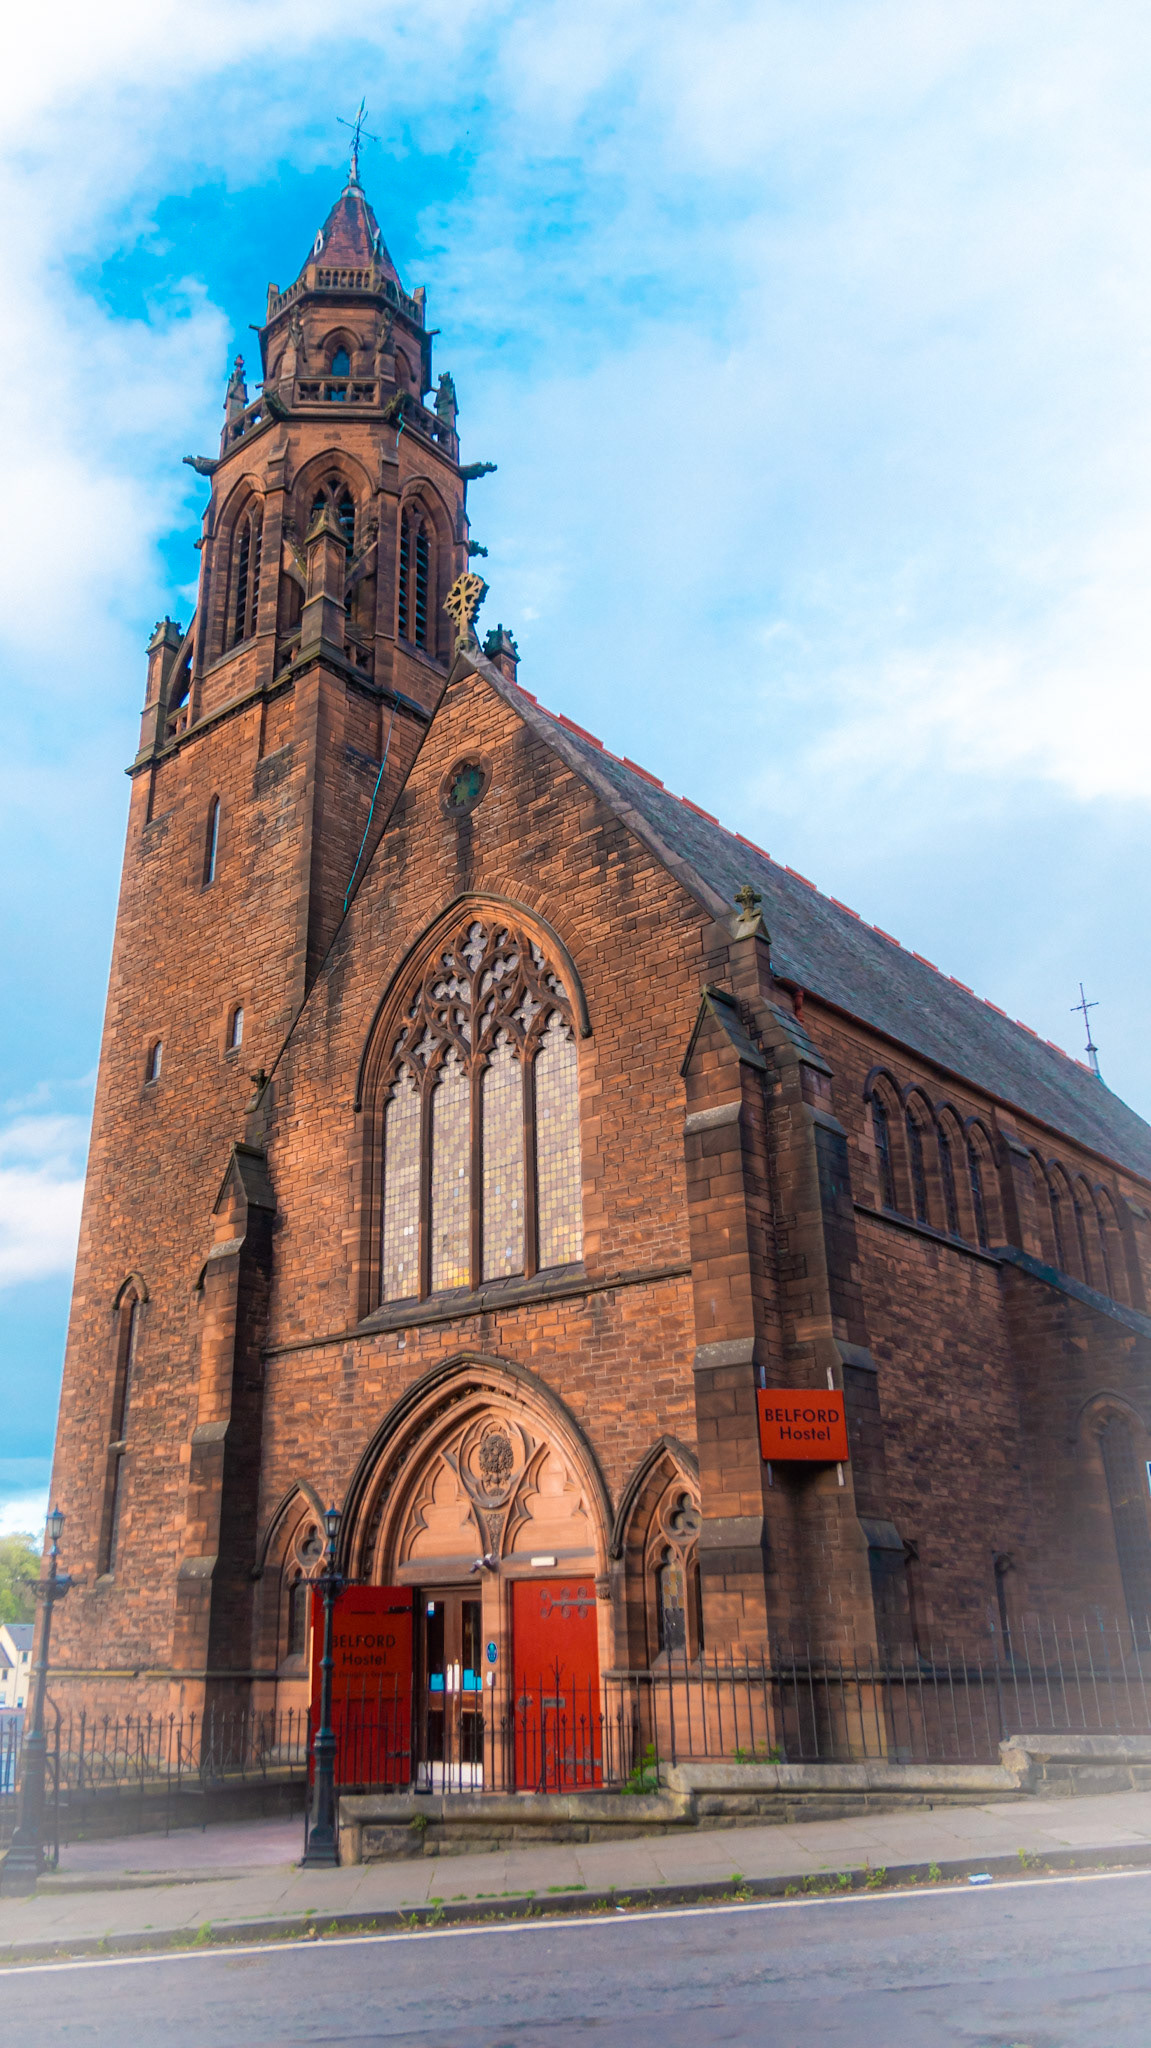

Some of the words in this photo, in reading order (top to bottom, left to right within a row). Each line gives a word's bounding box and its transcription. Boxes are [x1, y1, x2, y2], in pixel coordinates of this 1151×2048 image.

[764, 1408, 839, 1423] BELFORD
[779, 1426, 831, 1440] Hostel
[331, 1634, 396, 1648] BELFORD
[342, 1651, 387, 1665] Hostel
